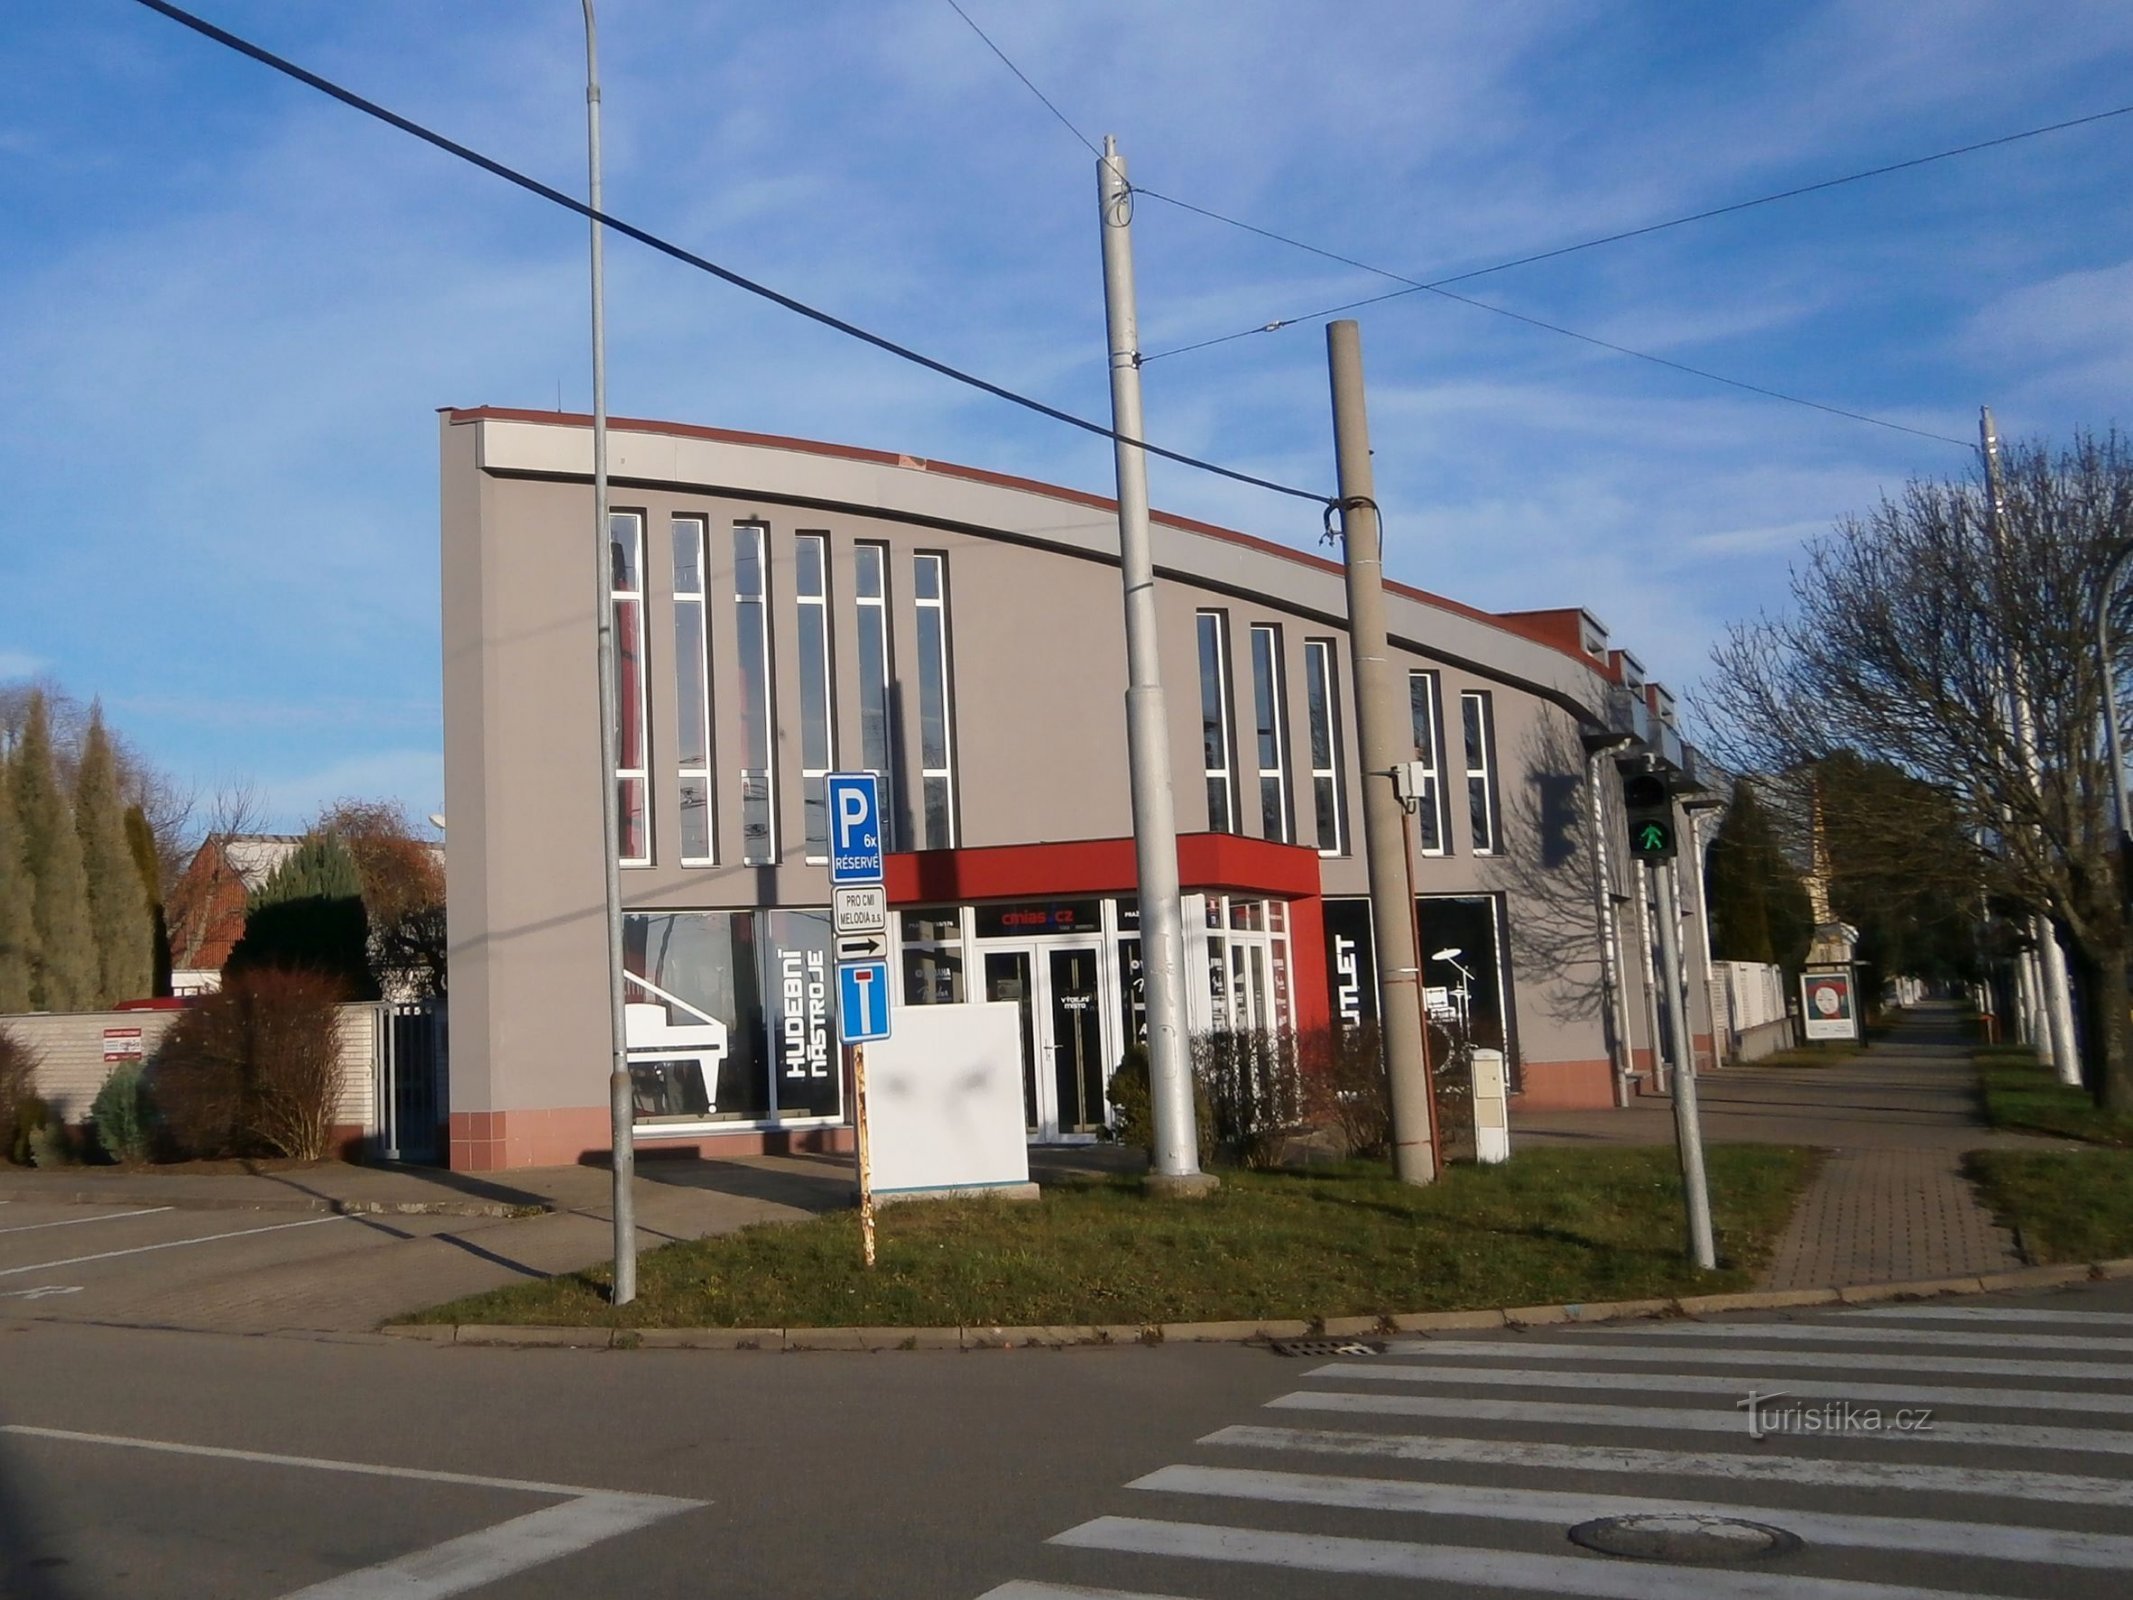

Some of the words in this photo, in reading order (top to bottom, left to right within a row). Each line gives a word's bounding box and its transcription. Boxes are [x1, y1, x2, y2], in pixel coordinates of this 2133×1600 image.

[838, 787, 868, 848] P
[863, 834, 878, 848] 6x
[835, 854, 879, 870] RÉSERVÉ
[846, 895, 861, 907] PRO
[862, 893, 875, 906] CMI
[840, 912, 871, 925] MELODIA
[871, 912, 882, 924] a.s.
